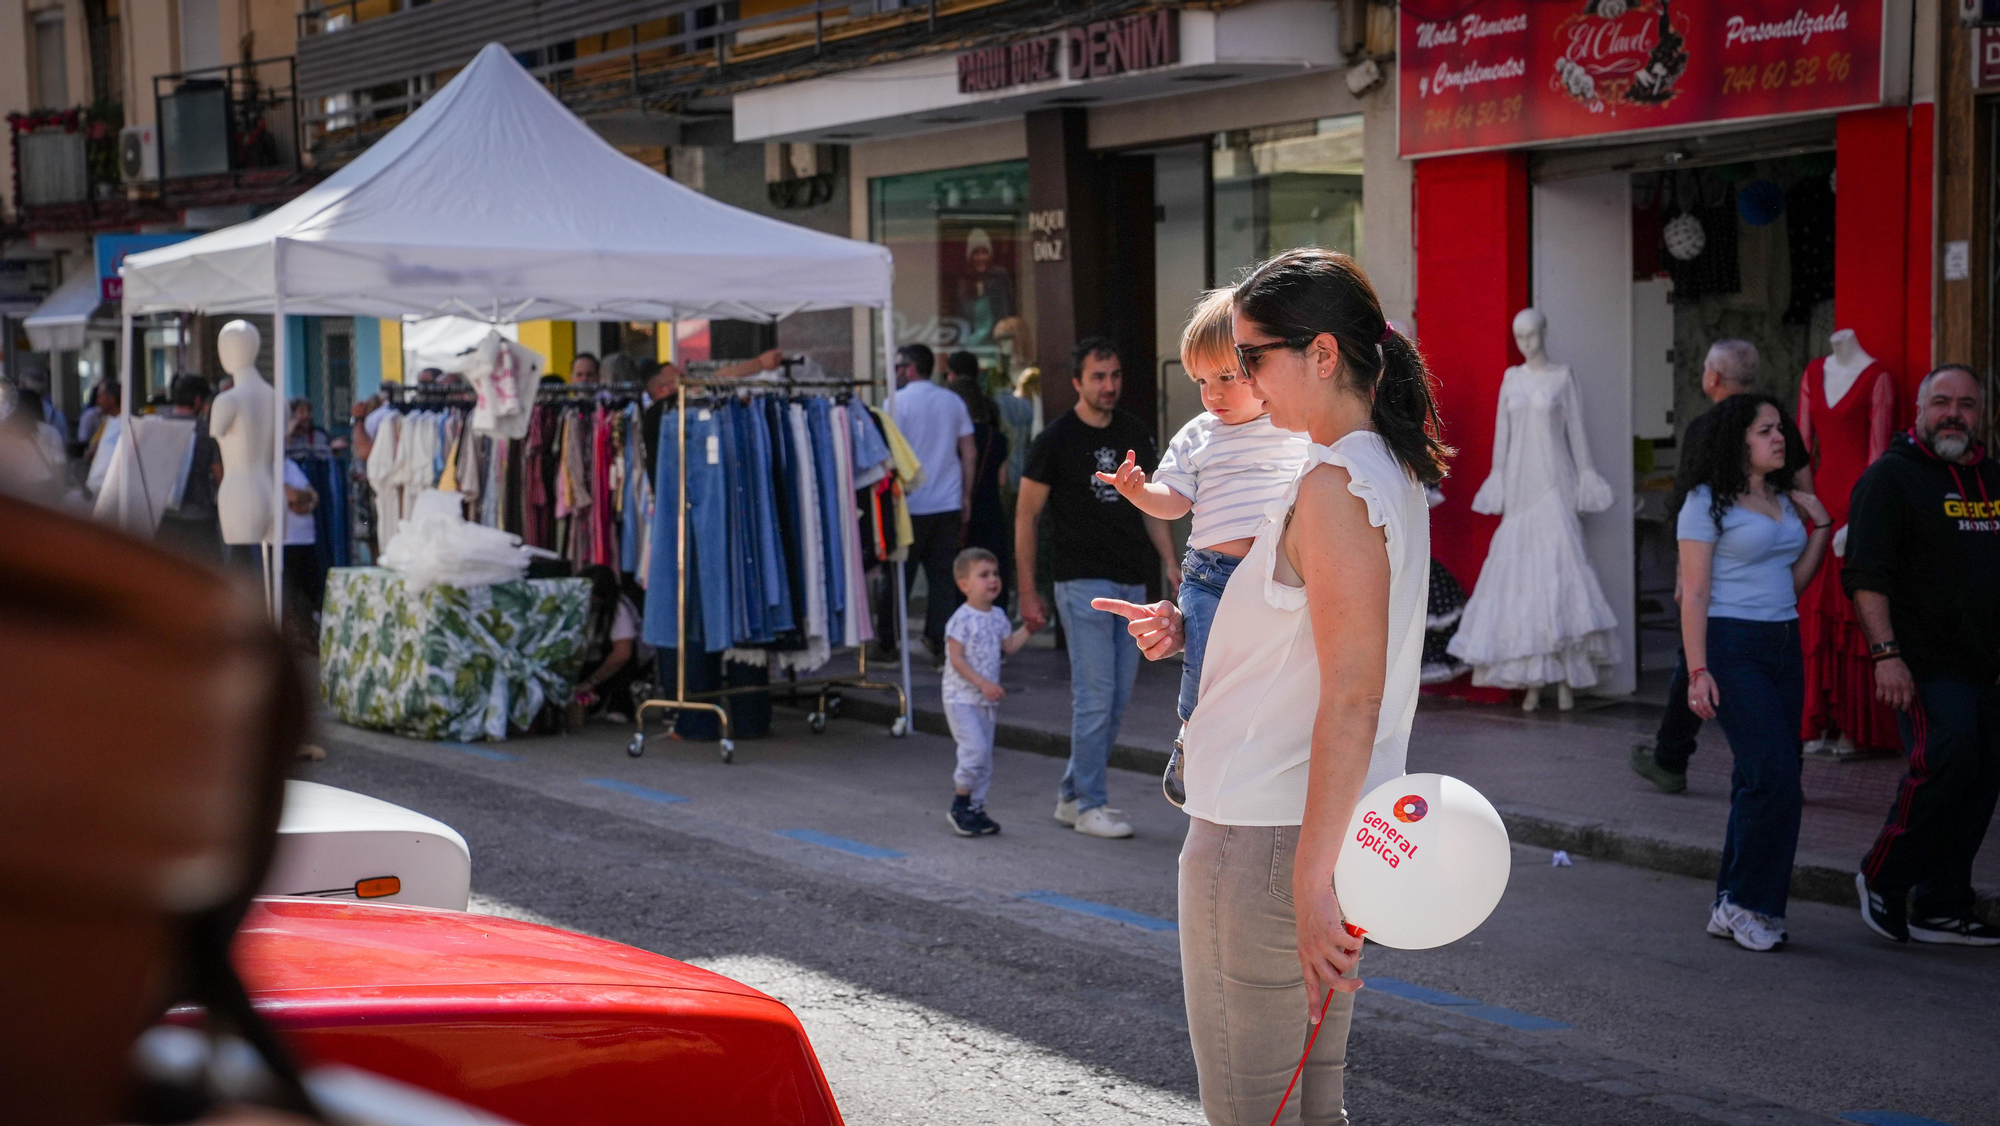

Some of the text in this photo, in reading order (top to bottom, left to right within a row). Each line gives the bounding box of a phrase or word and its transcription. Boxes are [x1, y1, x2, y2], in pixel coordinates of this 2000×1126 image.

[1416, 13, 1527, 48] Moda Flamenca
[1565, 17, 1653, 60] El Clavel
[1725, 3, 1848, 49] Personalizada
[957, 47, 1006, 93] PAQUI
[1067, 9, 1170, 80] DENIM
[1419, 56, 1525, 99] y Complementos
[1722, 51, 1852, 95] 744 60 32 96
[1029, 210, 1065, 235] PAQUI
[1356, 827, 1400, 869] Optica
[1363, 811, 1418, 860] General
